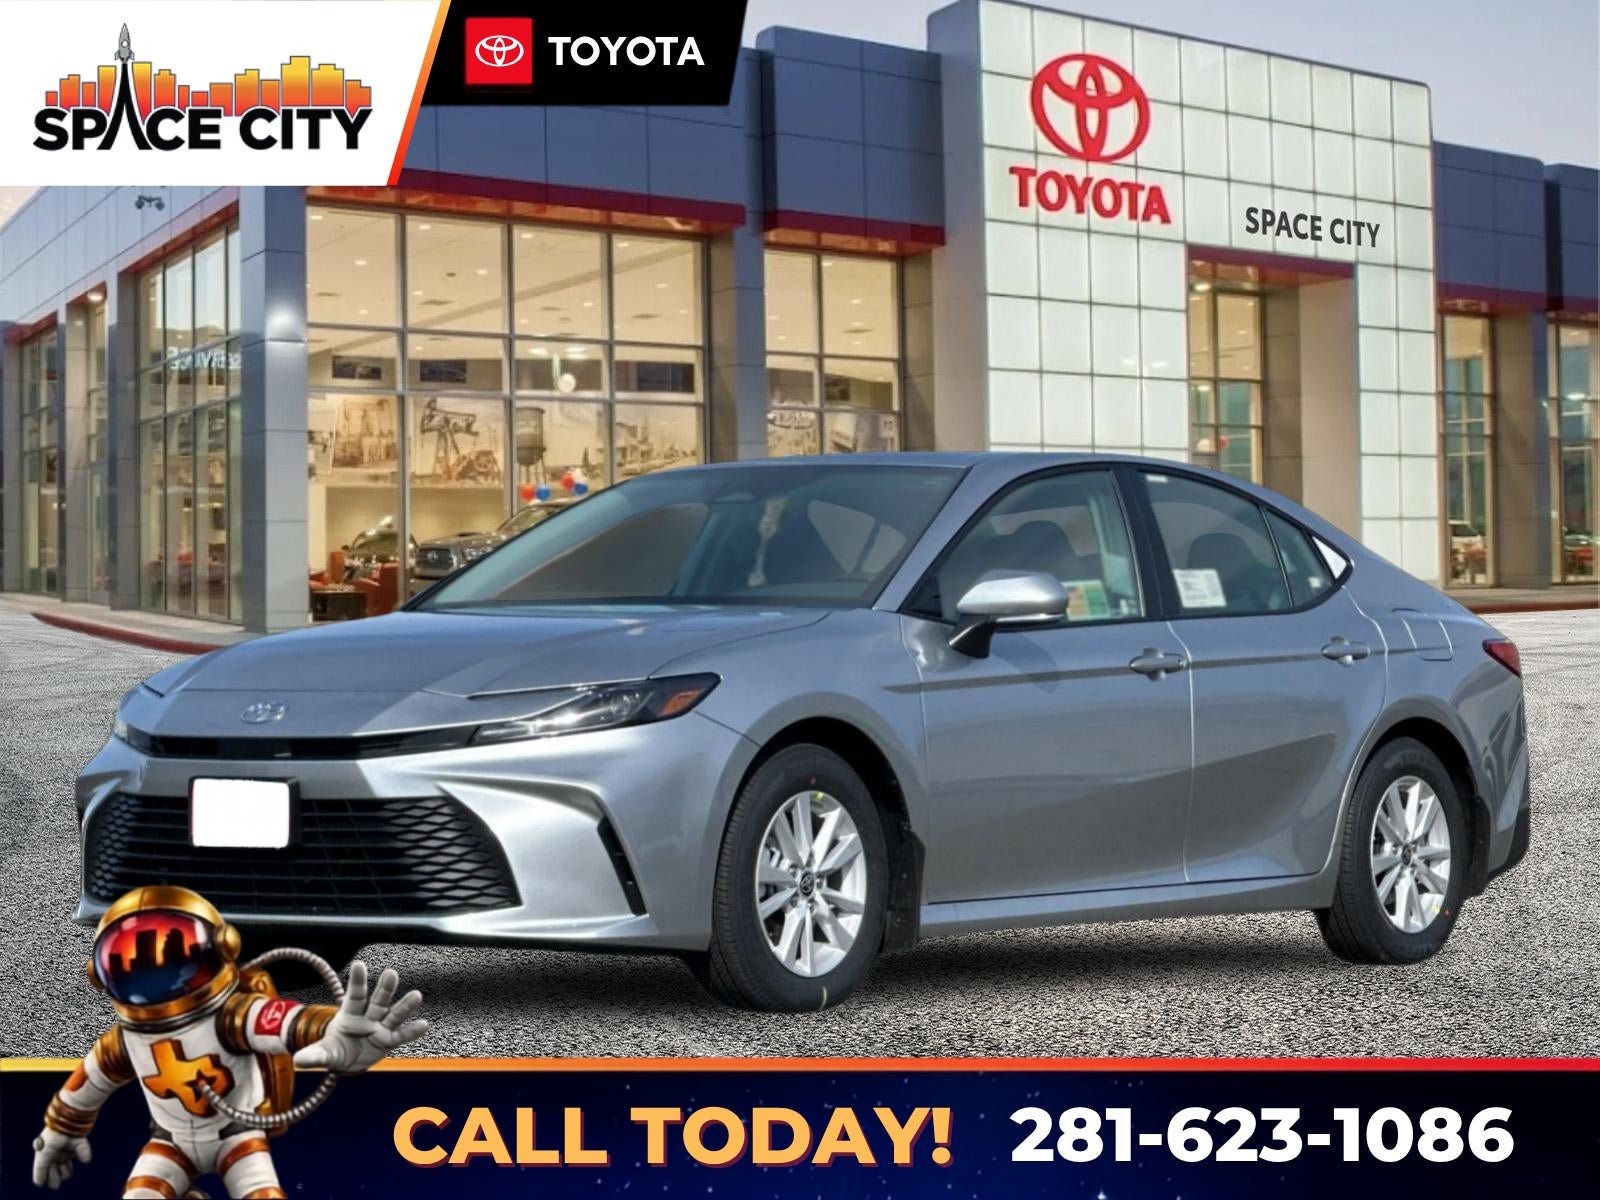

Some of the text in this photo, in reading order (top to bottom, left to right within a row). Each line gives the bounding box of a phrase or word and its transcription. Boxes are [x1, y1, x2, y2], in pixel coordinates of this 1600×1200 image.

[1009, 166, 1171, 224] TOYOTA
[1245, 206, 1381, 248] SPACE CITY
